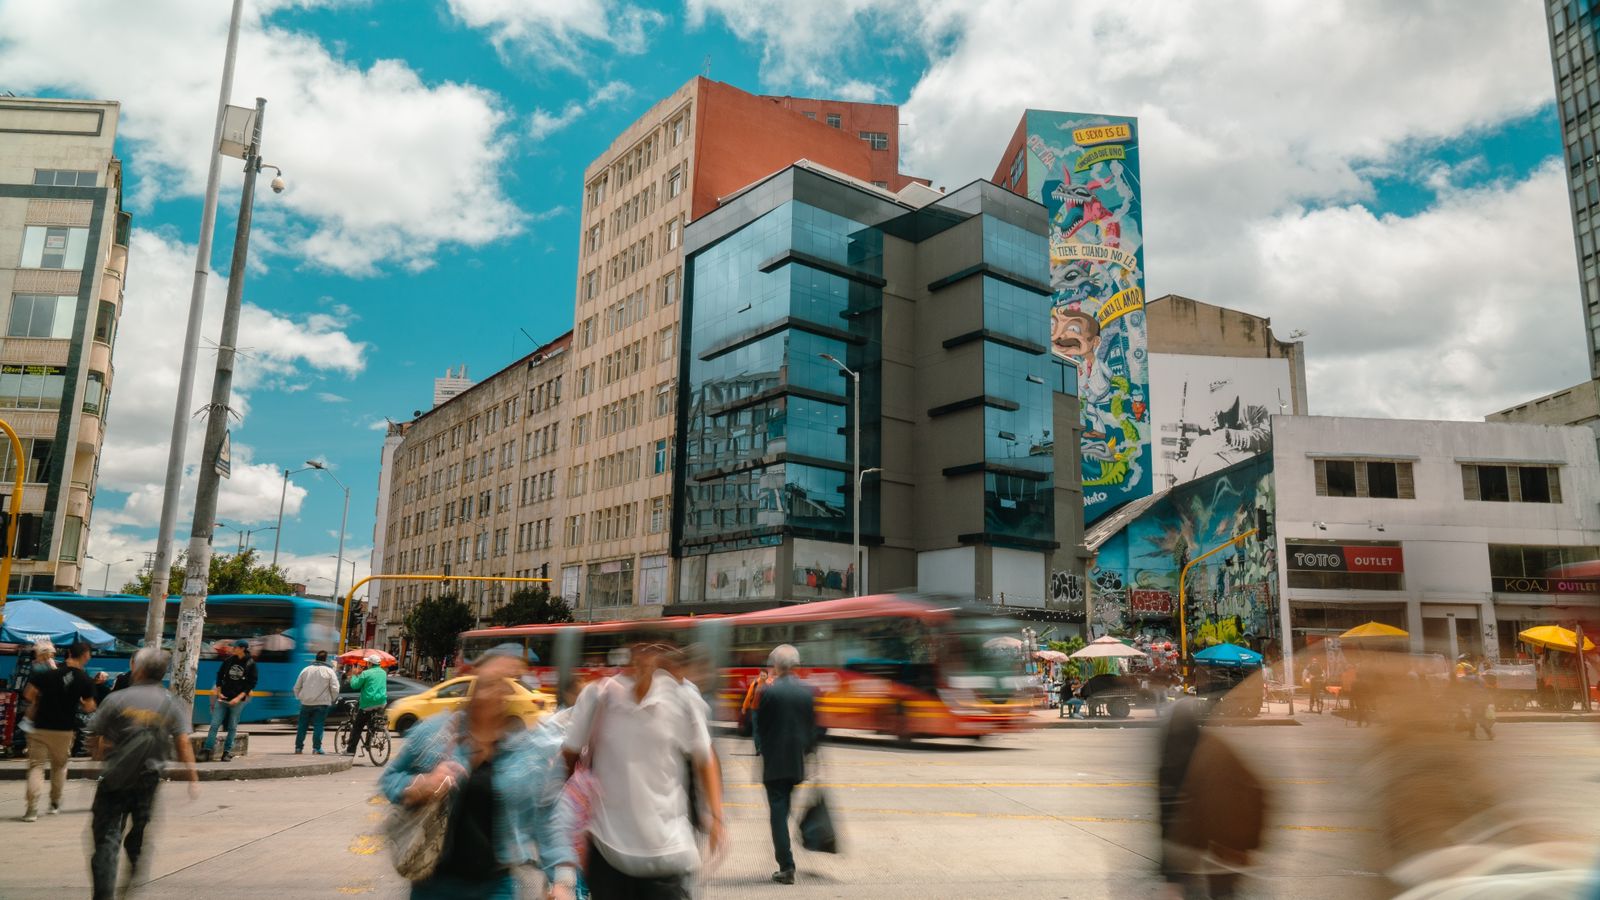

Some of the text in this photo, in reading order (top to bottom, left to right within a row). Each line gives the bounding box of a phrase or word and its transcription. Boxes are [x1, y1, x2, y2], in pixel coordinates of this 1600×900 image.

[1075, 126, 1126, 142] EL SEXO ES EL
[1057, 245, 1135, 268] TIENE CUANDO NO LE
[1114, 298, 1123, 311] EL
[1122, 288, 1141, 308] AMOR
[1295, 553, 1393, 567] TOTTO OUTLET
[1504, 578, 1597, 592] KOAJ OUTLET
